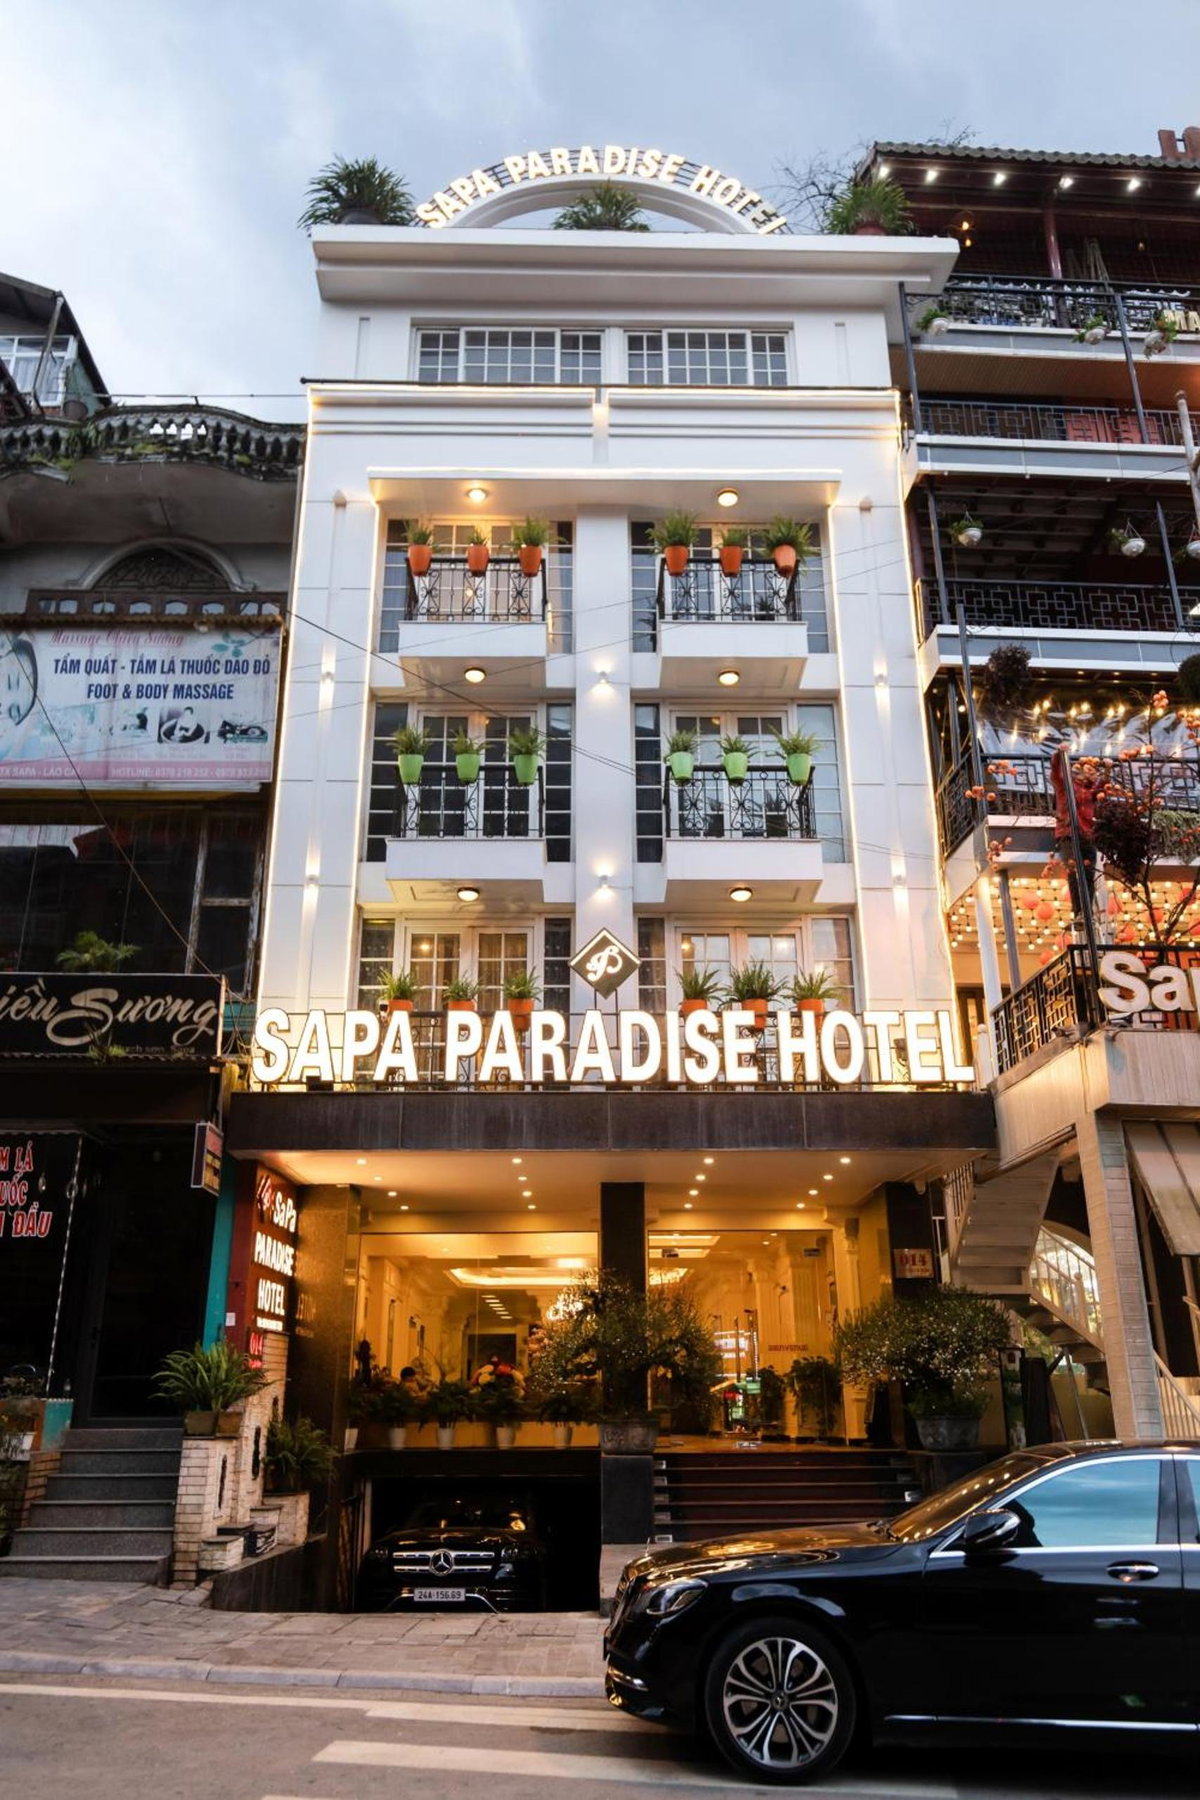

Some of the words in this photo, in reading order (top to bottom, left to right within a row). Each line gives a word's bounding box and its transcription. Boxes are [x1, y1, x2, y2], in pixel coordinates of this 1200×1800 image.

[416, 169, 503, 229] SAPA
[503, 145, 684, 183] PARADISE
[690, 164, 787, 234] HOTEL
[160, 656, 175, 674] LÁ
[180, 654, 220, 674] THUỐC
[224, 660, 249, 674] DAO
[253, 654, 270, 674] ĐỎ
[87, 684, 118, 699] FOOT
[122, 684, 131, 699] &
[136, 684, 169, 699] BODY
[173, 684, 234, 699] MASSAGE
[1098, 951, 1200, 1024] Sa
[46, 988, 217, 1046] Sương
[251, 1008, 419, 1083] SAPA
[445, 1009, 759, 1083] PARADISE
[777, 1009, 976, 1083] HOTEL
[14, 1140, 34, 1172] LÁ
[273, 1191, 297, 1233] SaPa
[254, 1231, 296, 1277] PARADISE
[257, 1278, 285, 1316] HOTEL
